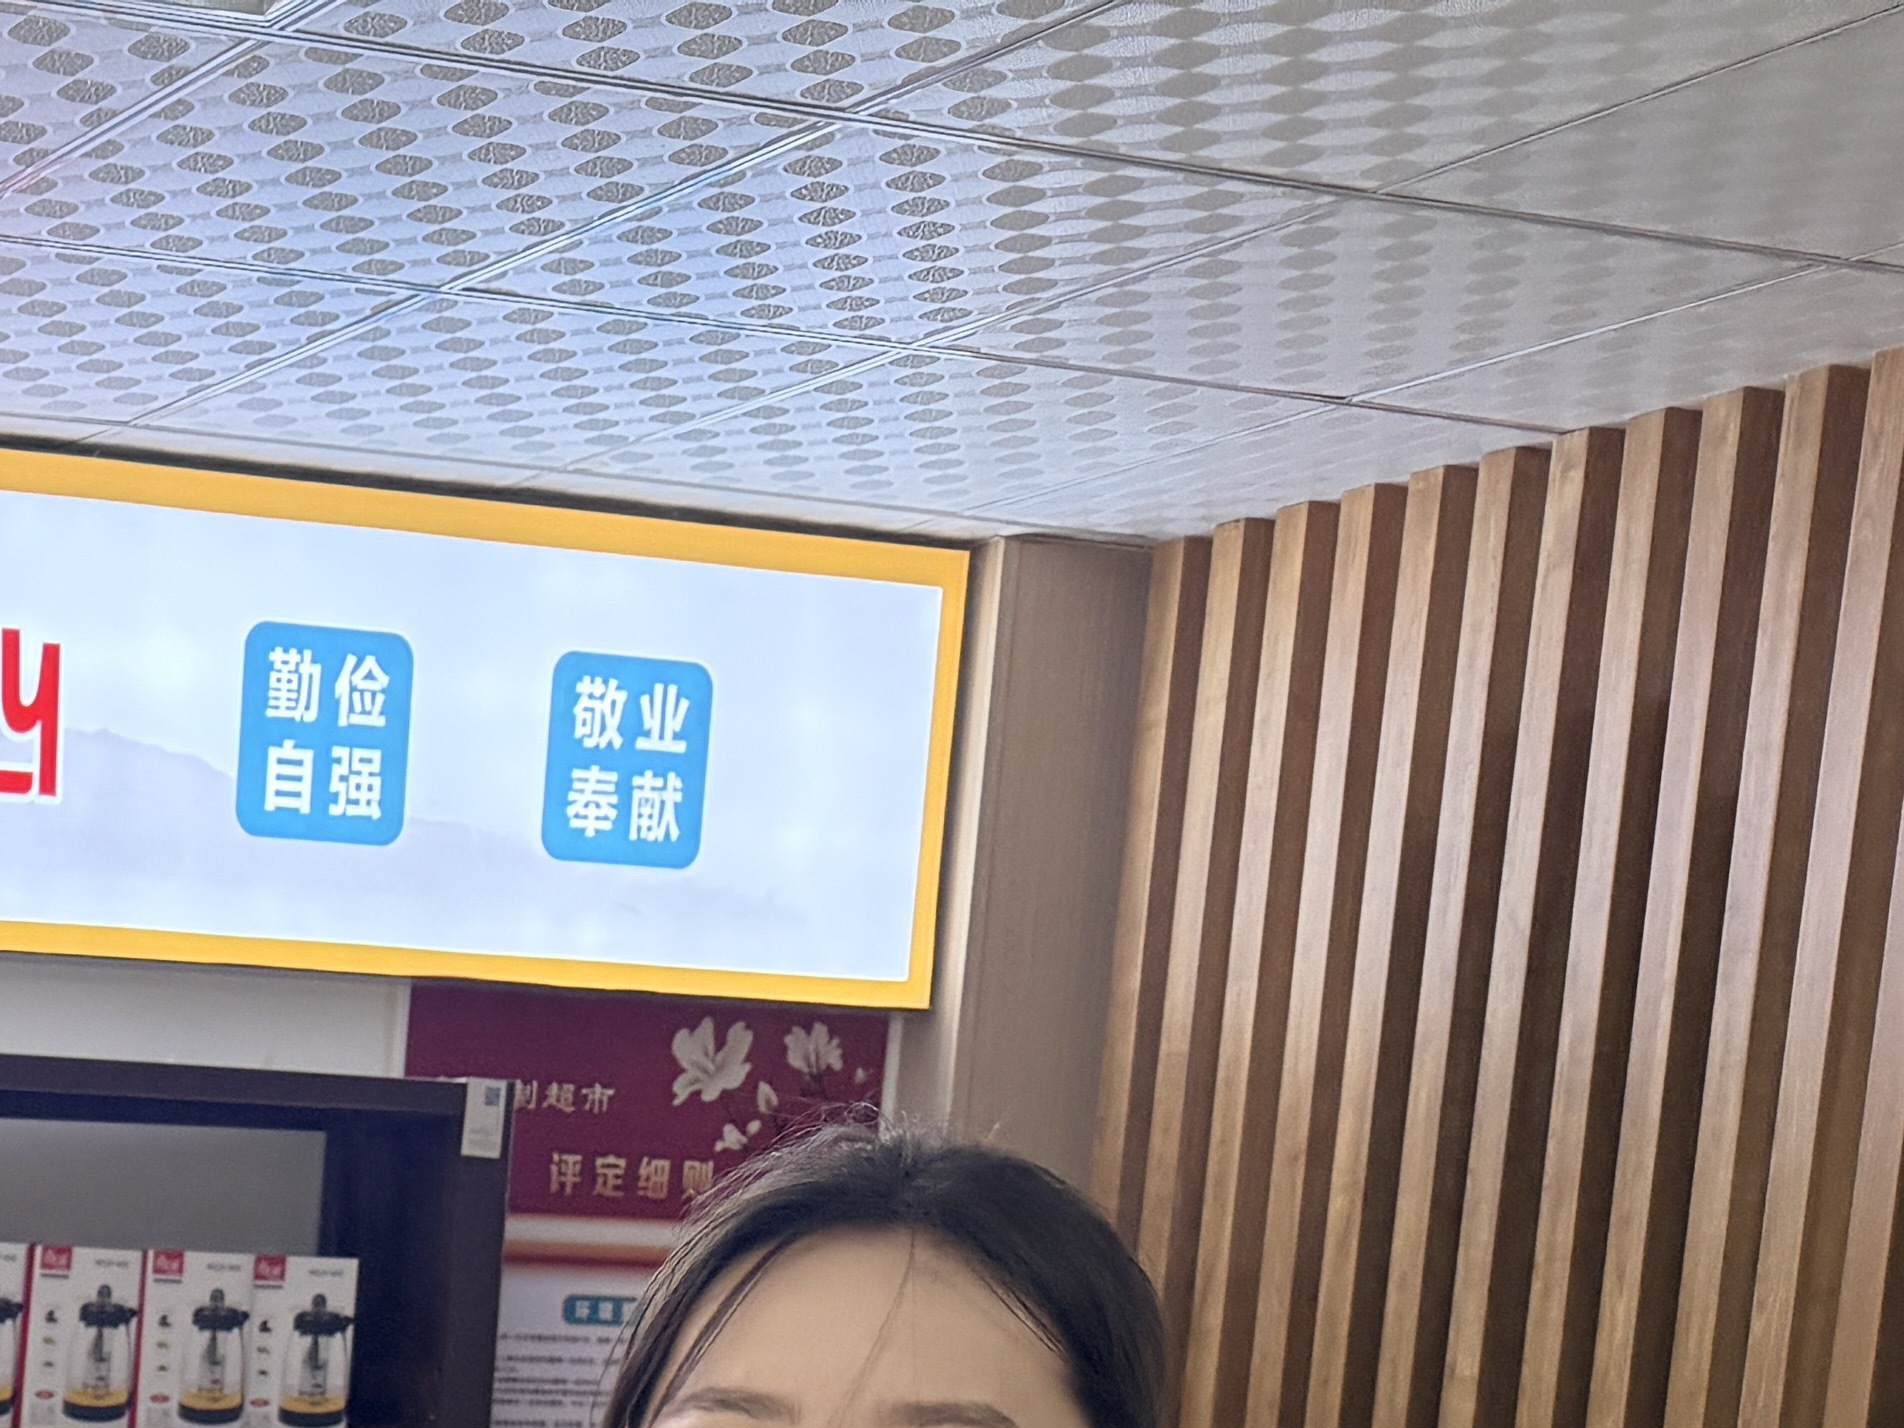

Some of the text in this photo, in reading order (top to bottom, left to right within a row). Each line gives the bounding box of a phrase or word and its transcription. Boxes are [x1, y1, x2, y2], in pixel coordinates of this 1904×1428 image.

[265, 646, 392, 729] 勤俭
[572, 674, 691, 756] 敬业
[263, 739, 383, 822] 自强
[566, 763, 684, 844] 奉献
[549, 1151, 715, 1199] 评定细则
